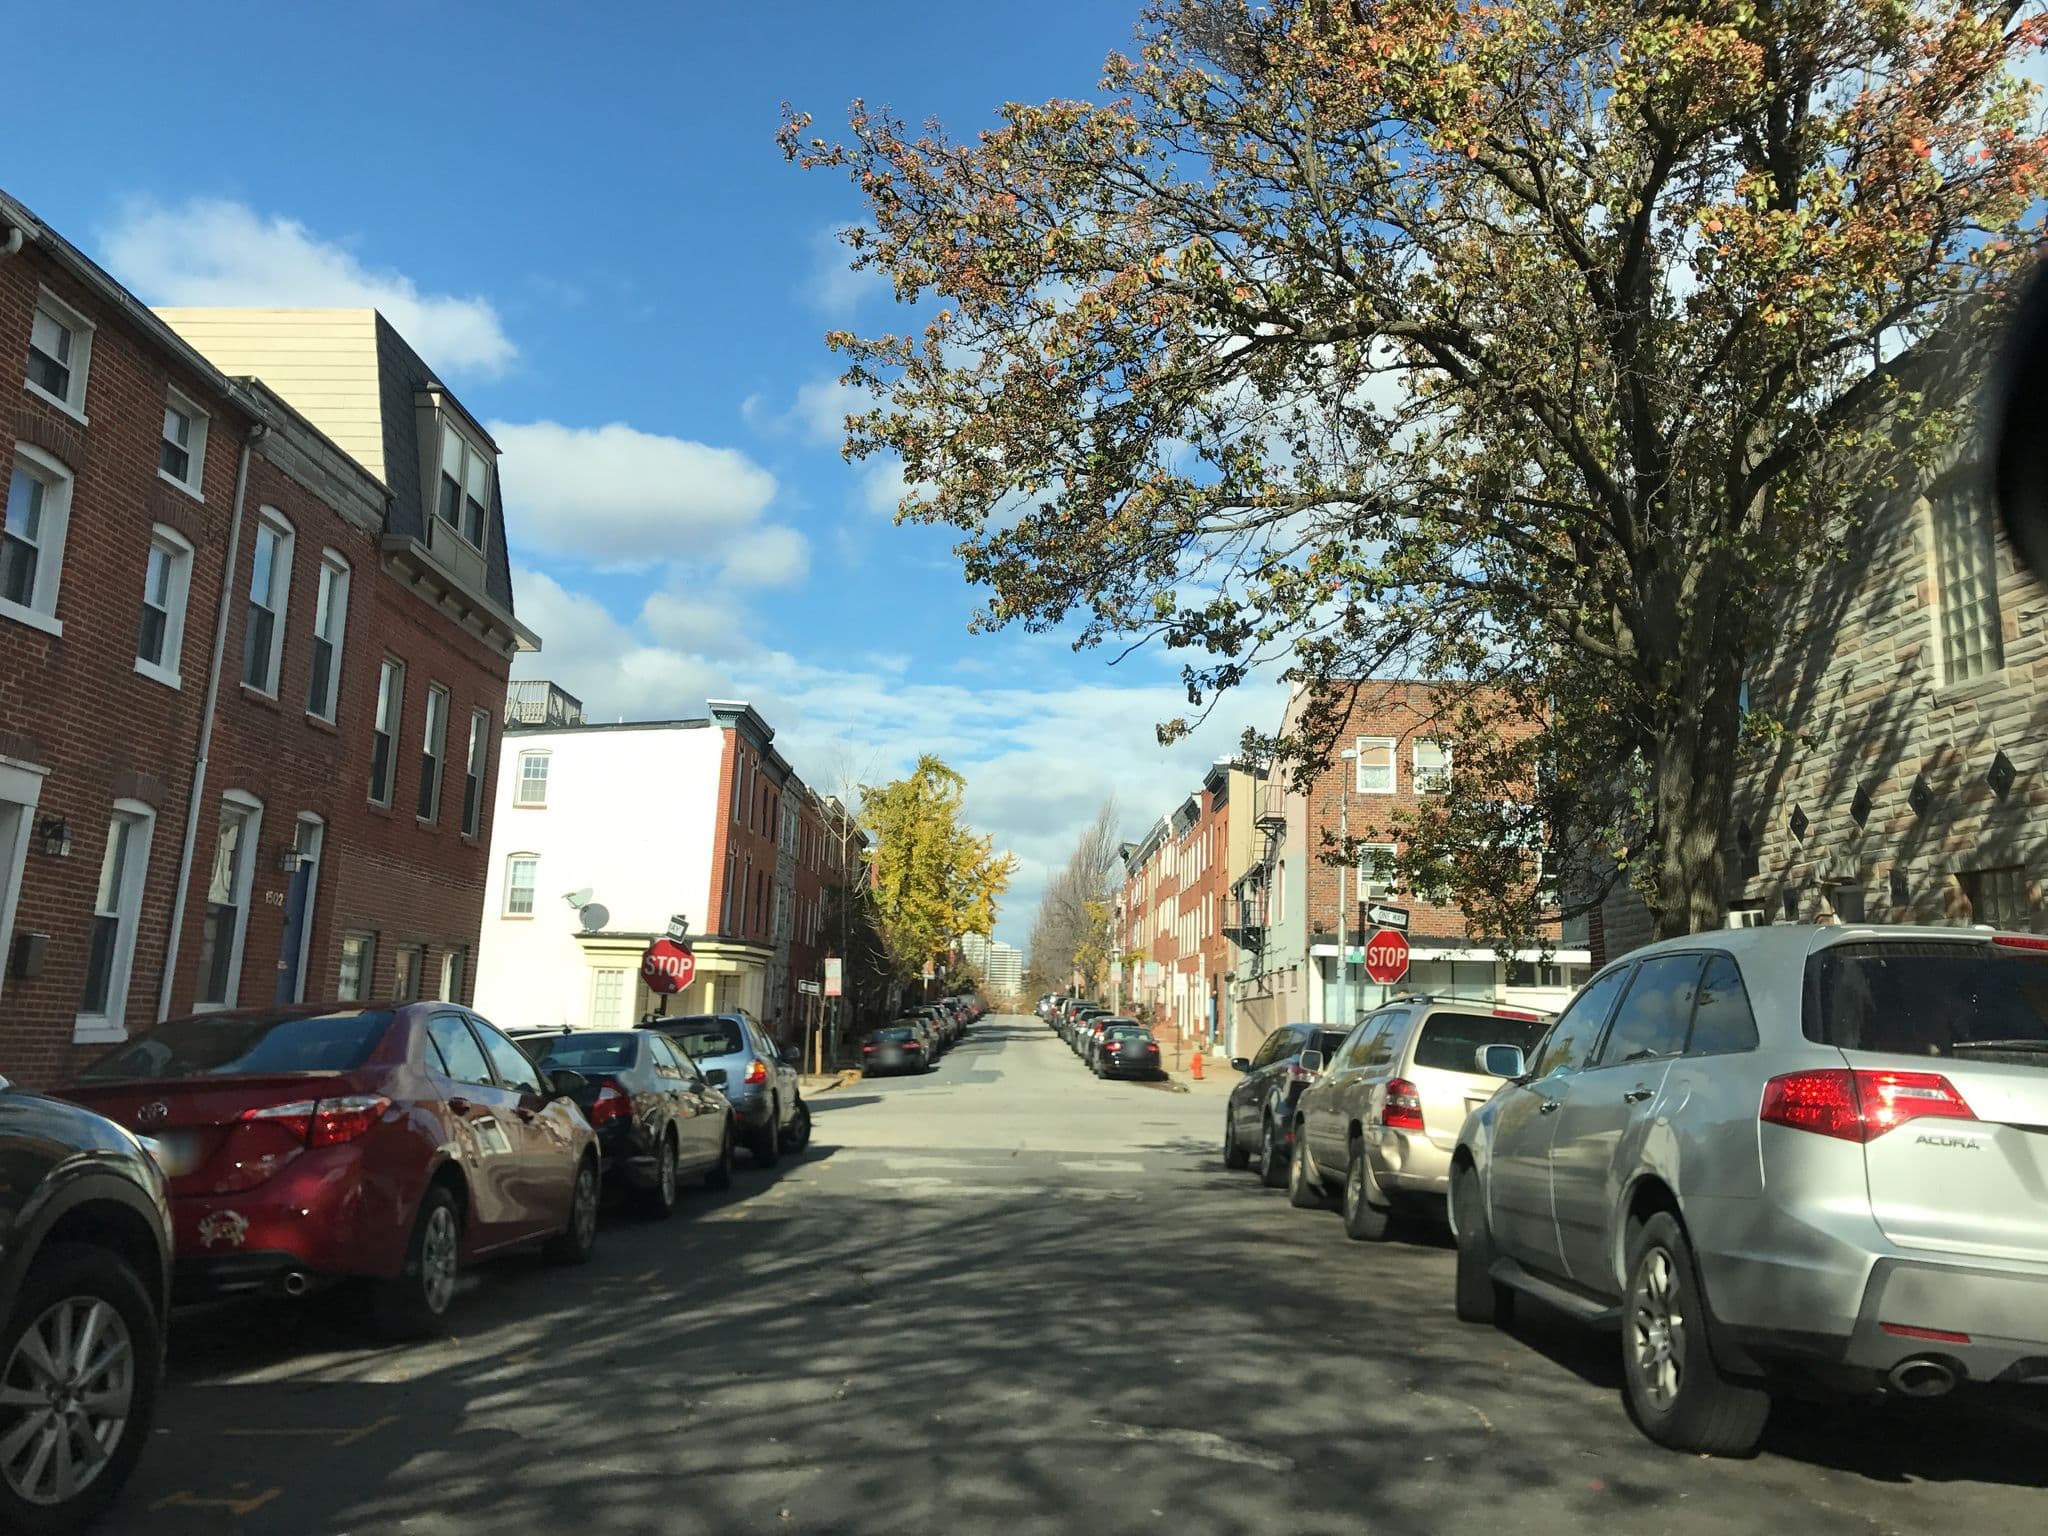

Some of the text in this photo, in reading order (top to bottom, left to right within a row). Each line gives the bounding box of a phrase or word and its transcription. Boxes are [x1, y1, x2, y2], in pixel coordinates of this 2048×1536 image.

[645, 955, 692, 978] STOP
[1368, 946, 1406, 967] STOP
[1914, 1135, 1980, 1149] ACURA
